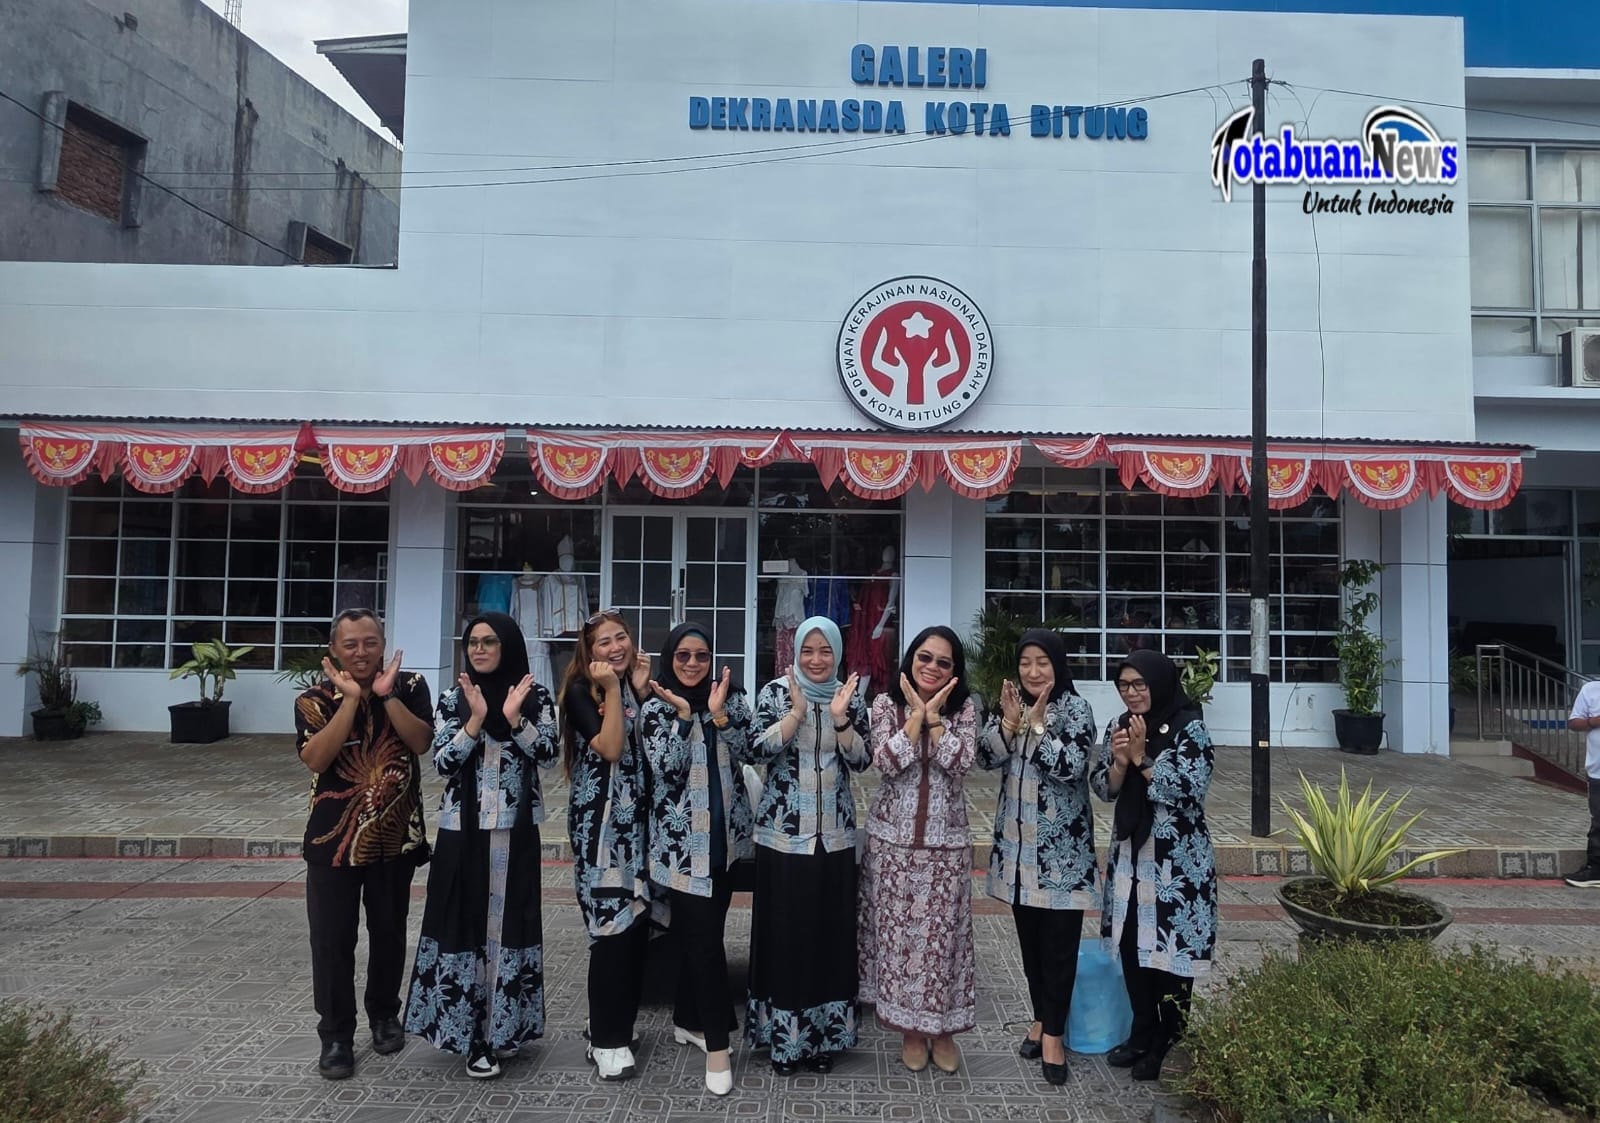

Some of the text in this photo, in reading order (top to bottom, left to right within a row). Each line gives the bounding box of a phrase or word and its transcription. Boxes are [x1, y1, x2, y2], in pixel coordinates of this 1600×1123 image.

[851, 43, 987, 88] GALERI
[689, 96, 1148, 140] DEKRANASDA KOTA BITUNG
[843, 284, 988, 391] DEWAN KERAJINAN NASIONAL DAERAH
[868, 397, 962, 421] KOTA BITUNG
